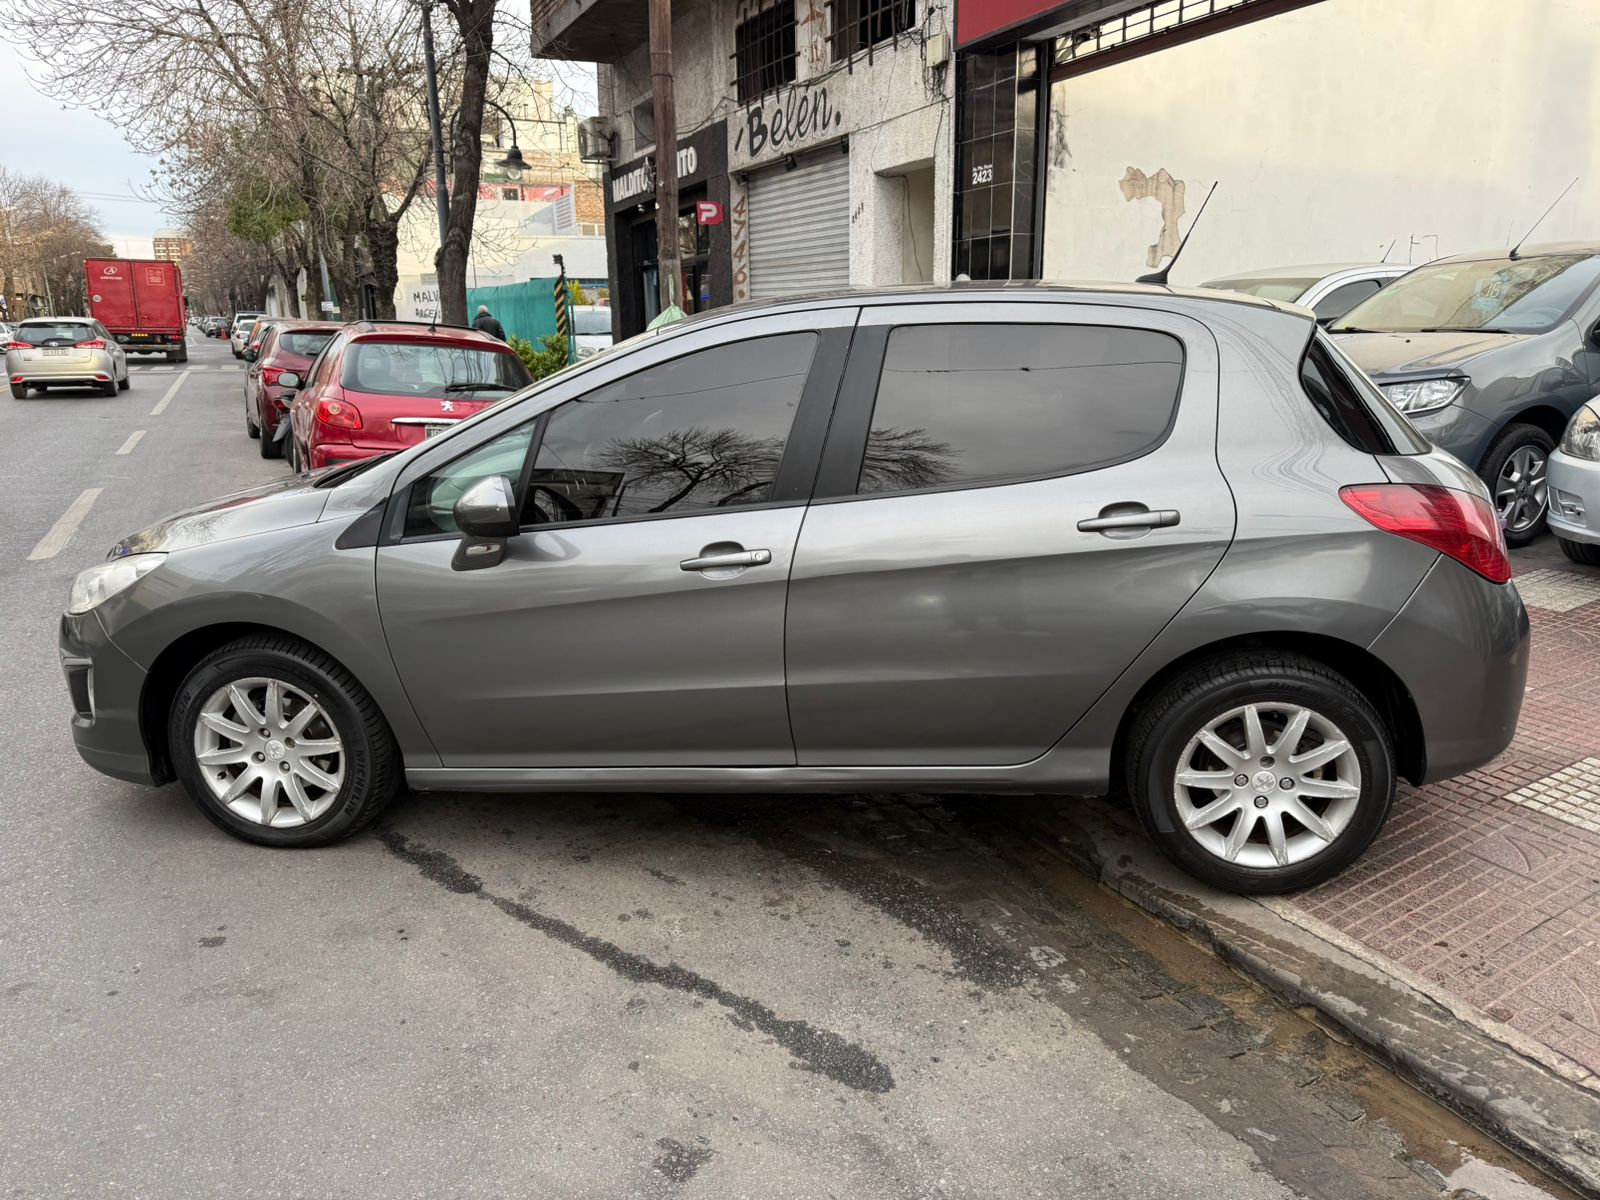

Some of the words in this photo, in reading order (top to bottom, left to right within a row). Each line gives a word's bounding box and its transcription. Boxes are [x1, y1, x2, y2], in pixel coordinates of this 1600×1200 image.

[972, 169, 992, 184] 2423
[413, 290, 440, 303] MALV
[344, 750, 367, 816] MICHELIN
